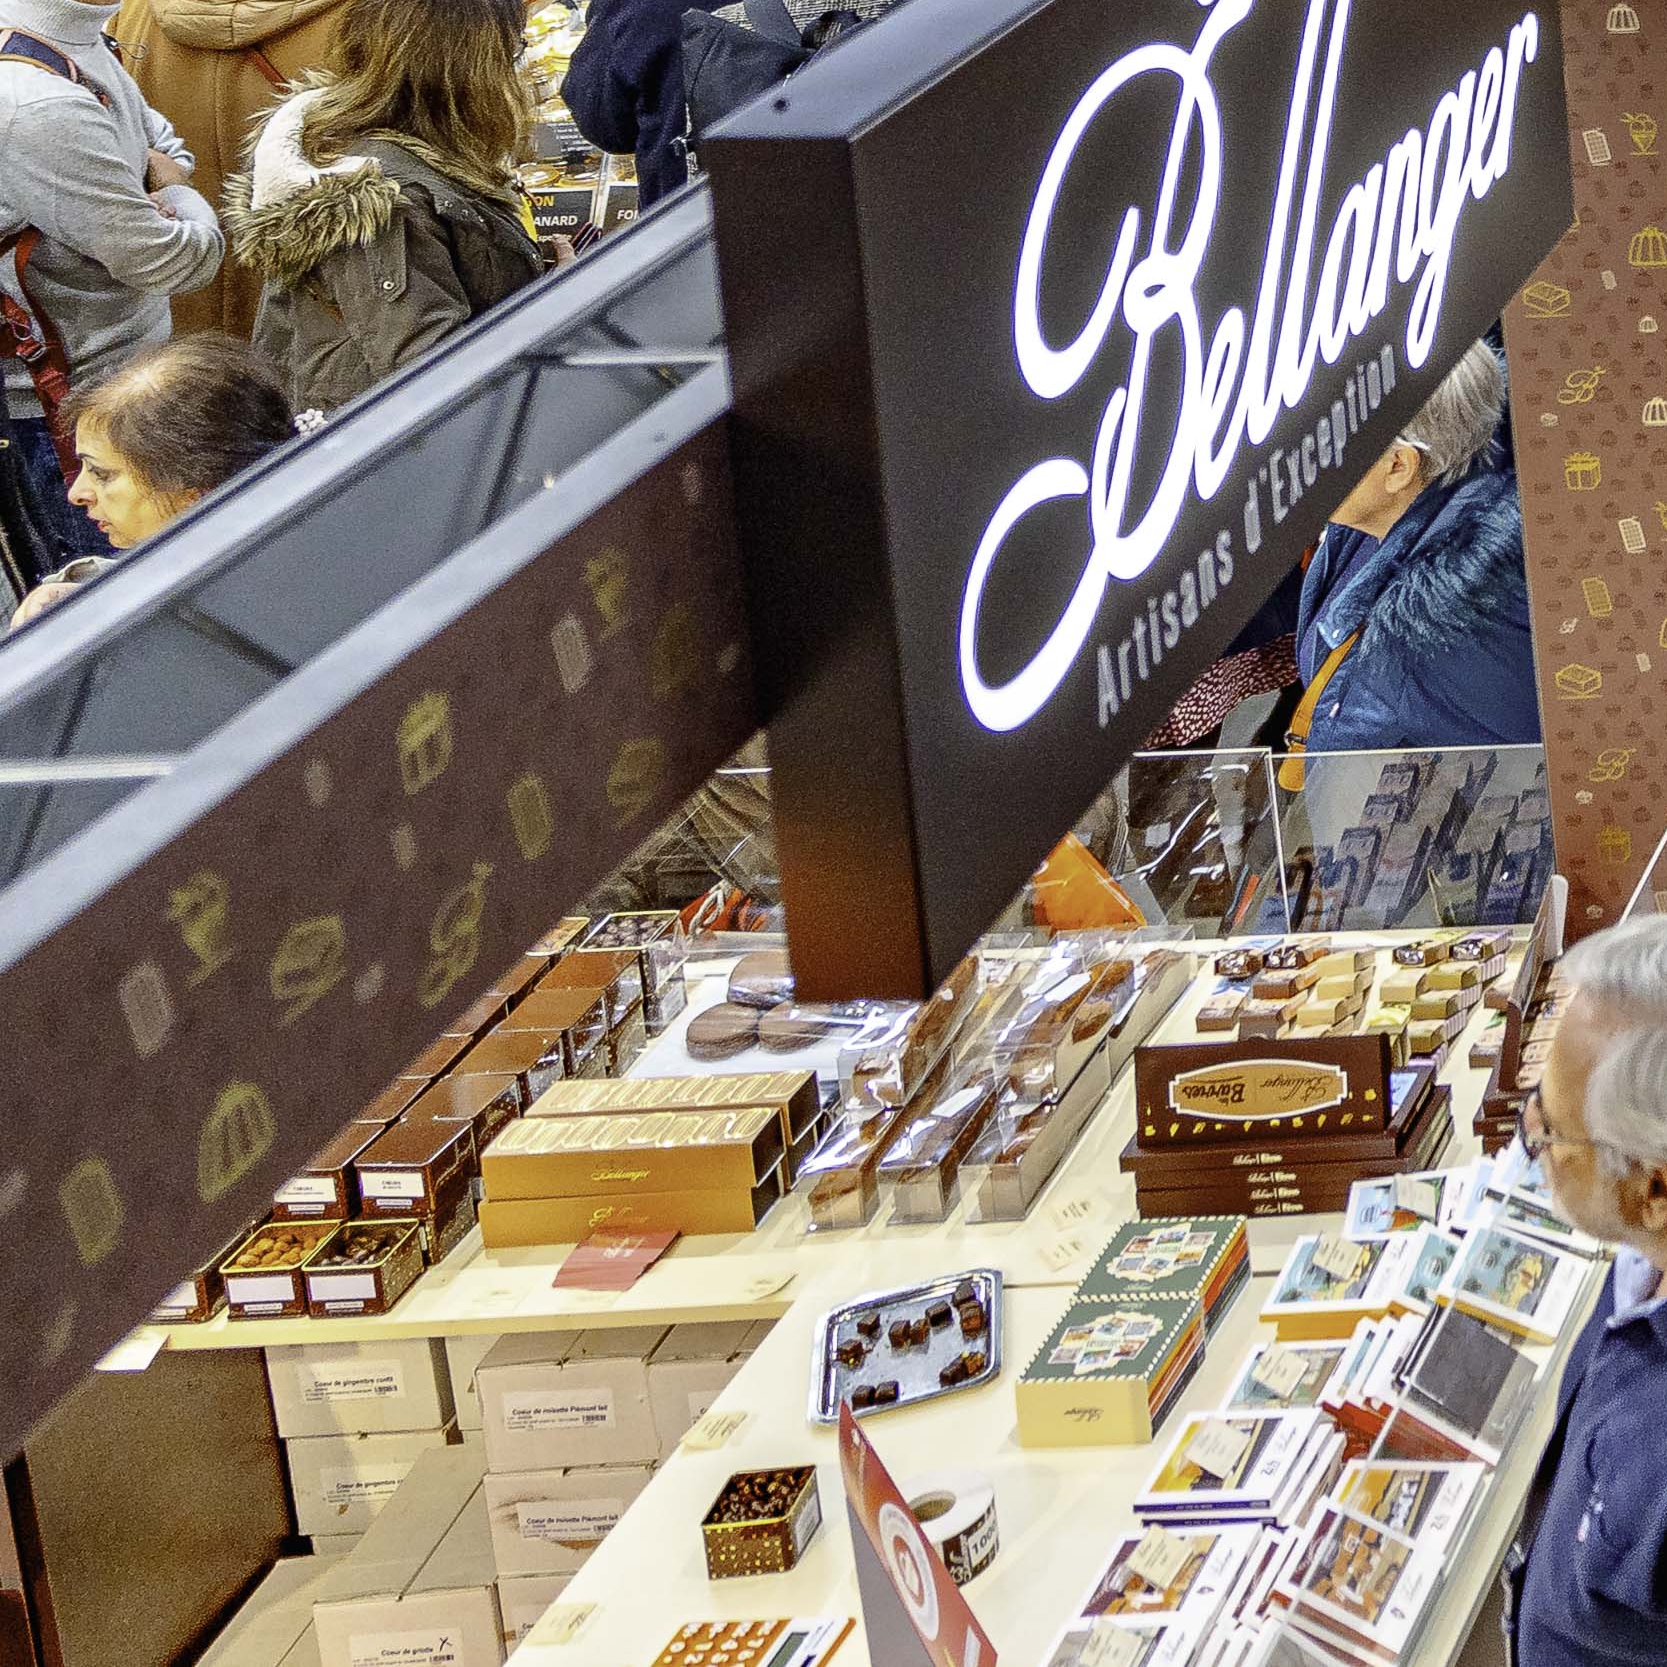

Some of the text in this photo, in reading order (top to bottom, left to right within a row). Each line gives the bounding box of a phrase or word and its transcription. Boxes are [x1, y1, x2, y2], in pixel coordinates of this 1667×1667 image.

[1095, 345, 1399, 728] Artisans d'Exception
[1182, 1083, 1245, 1103] Barres
[315, 1380, 332, 1388] Coeur
[512, 1407, 542, 1416] Coeur de
[527, 1517, 546, 1525] Coeur
[381, 1648, 411, 1658] Coeur de
